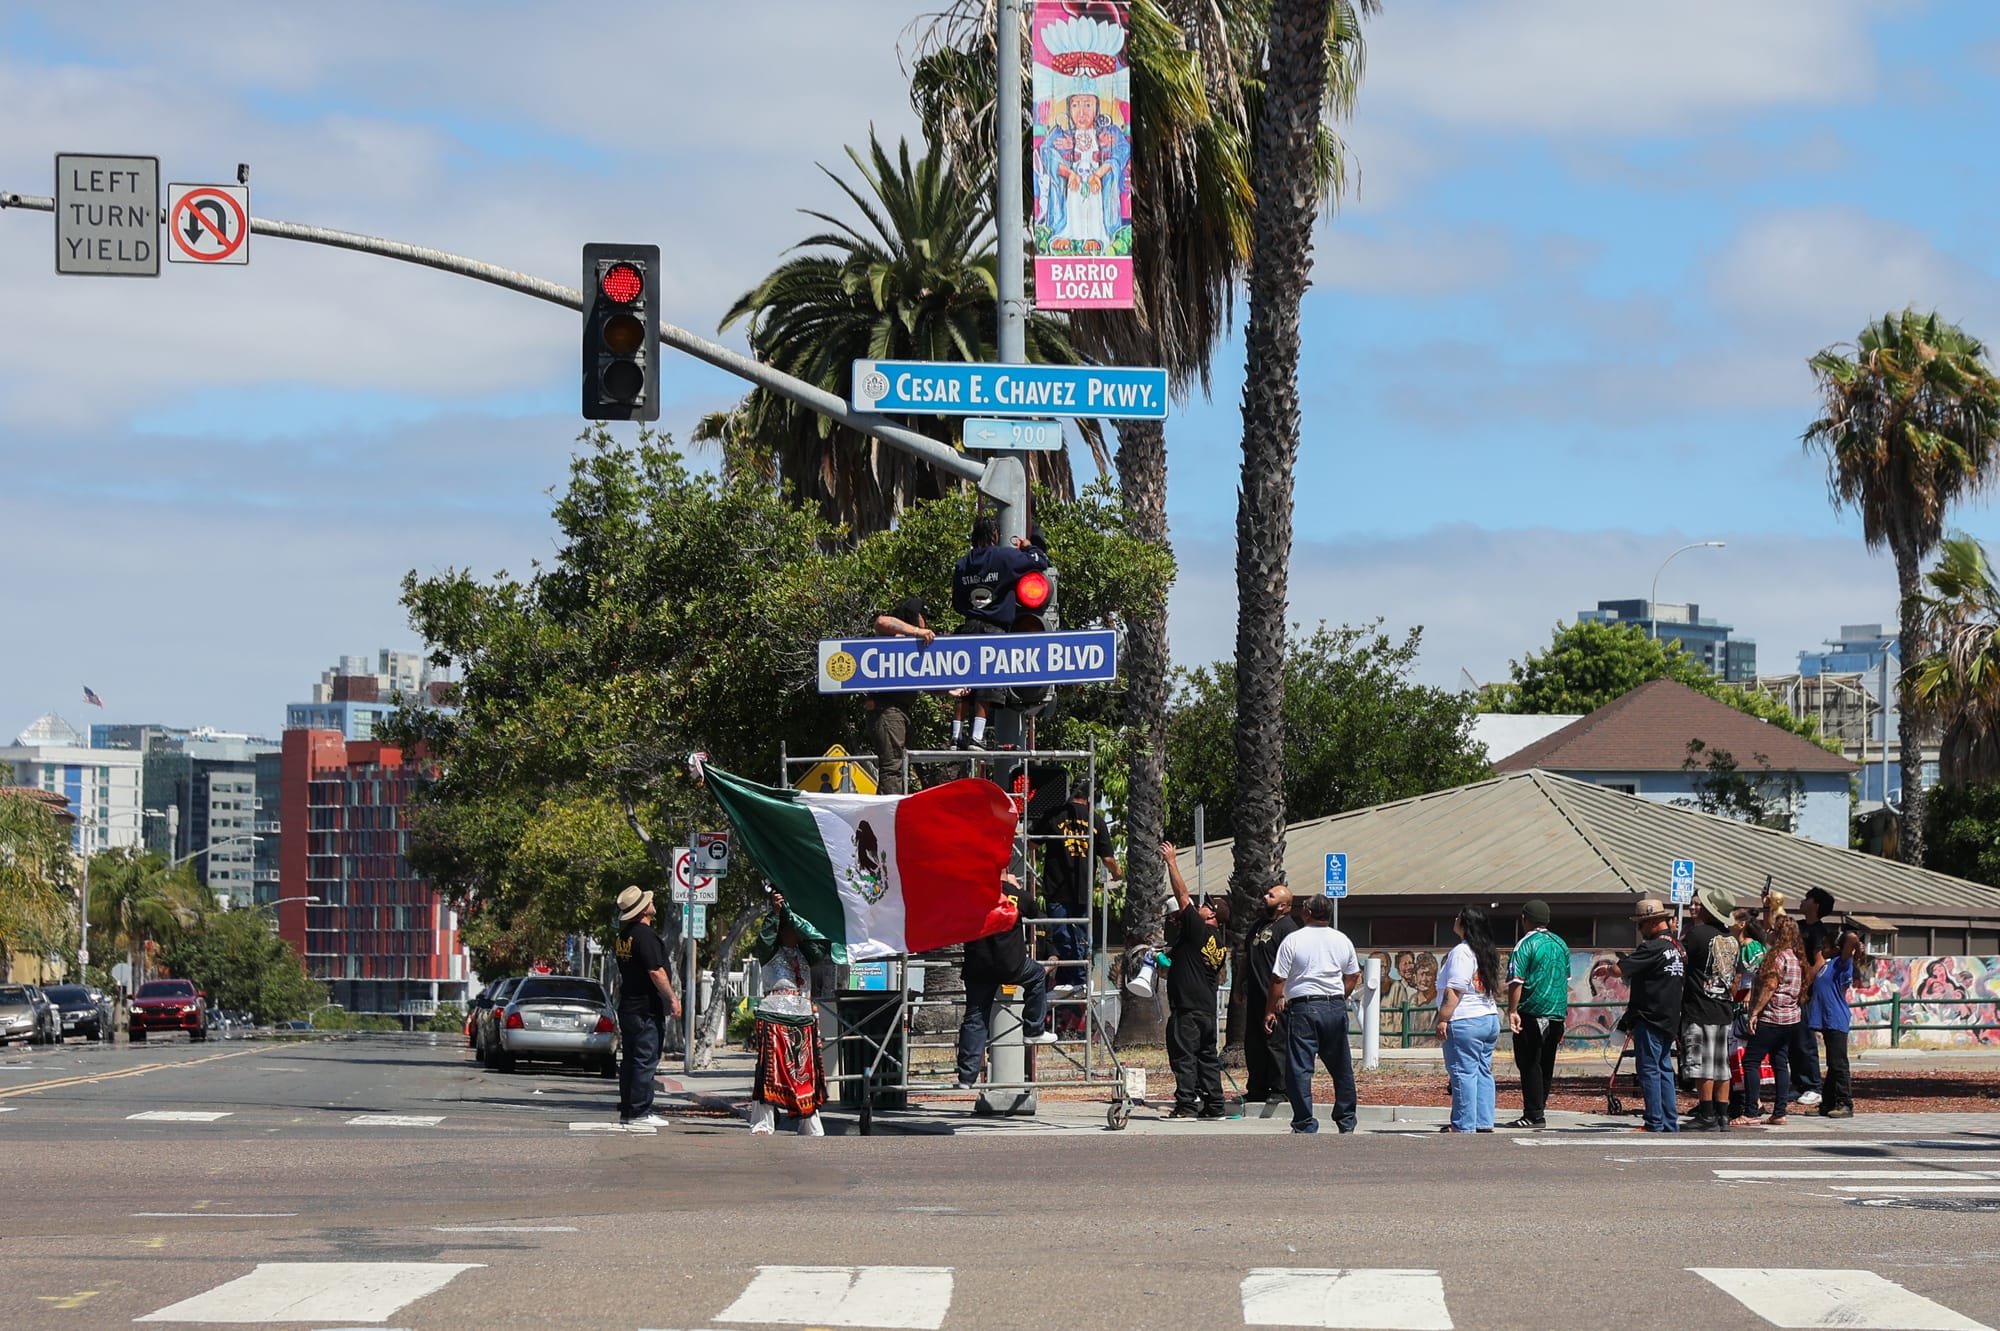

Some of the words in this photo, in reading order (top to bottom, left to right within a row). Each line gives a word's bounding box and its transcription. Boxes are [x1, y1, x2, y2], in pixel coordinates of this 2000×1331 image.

[73, 169, 140, 194] LEFT
[71, 204, 145, 229] TURN
[66, 237, 151, 262] YIELD
[1051, 264, 1118, 281] BARRIO
[1056, 281, 1114, 299] LOGAN
[896, 372, 960, 403] CESAR
[970, 375, 989, 404] E.
[995, 375, 1076, 406] CHAVEZ
[1088, 378, 1158, 409] PKWY.
[1012, 425, 1046, 443] 900
[860, 648, 971, 679] CHICANO
[980, 645, 1040, 675] PARK
[1048, 643, 1104, 672] BLVD
[699, 892, 715, 900] TONS
